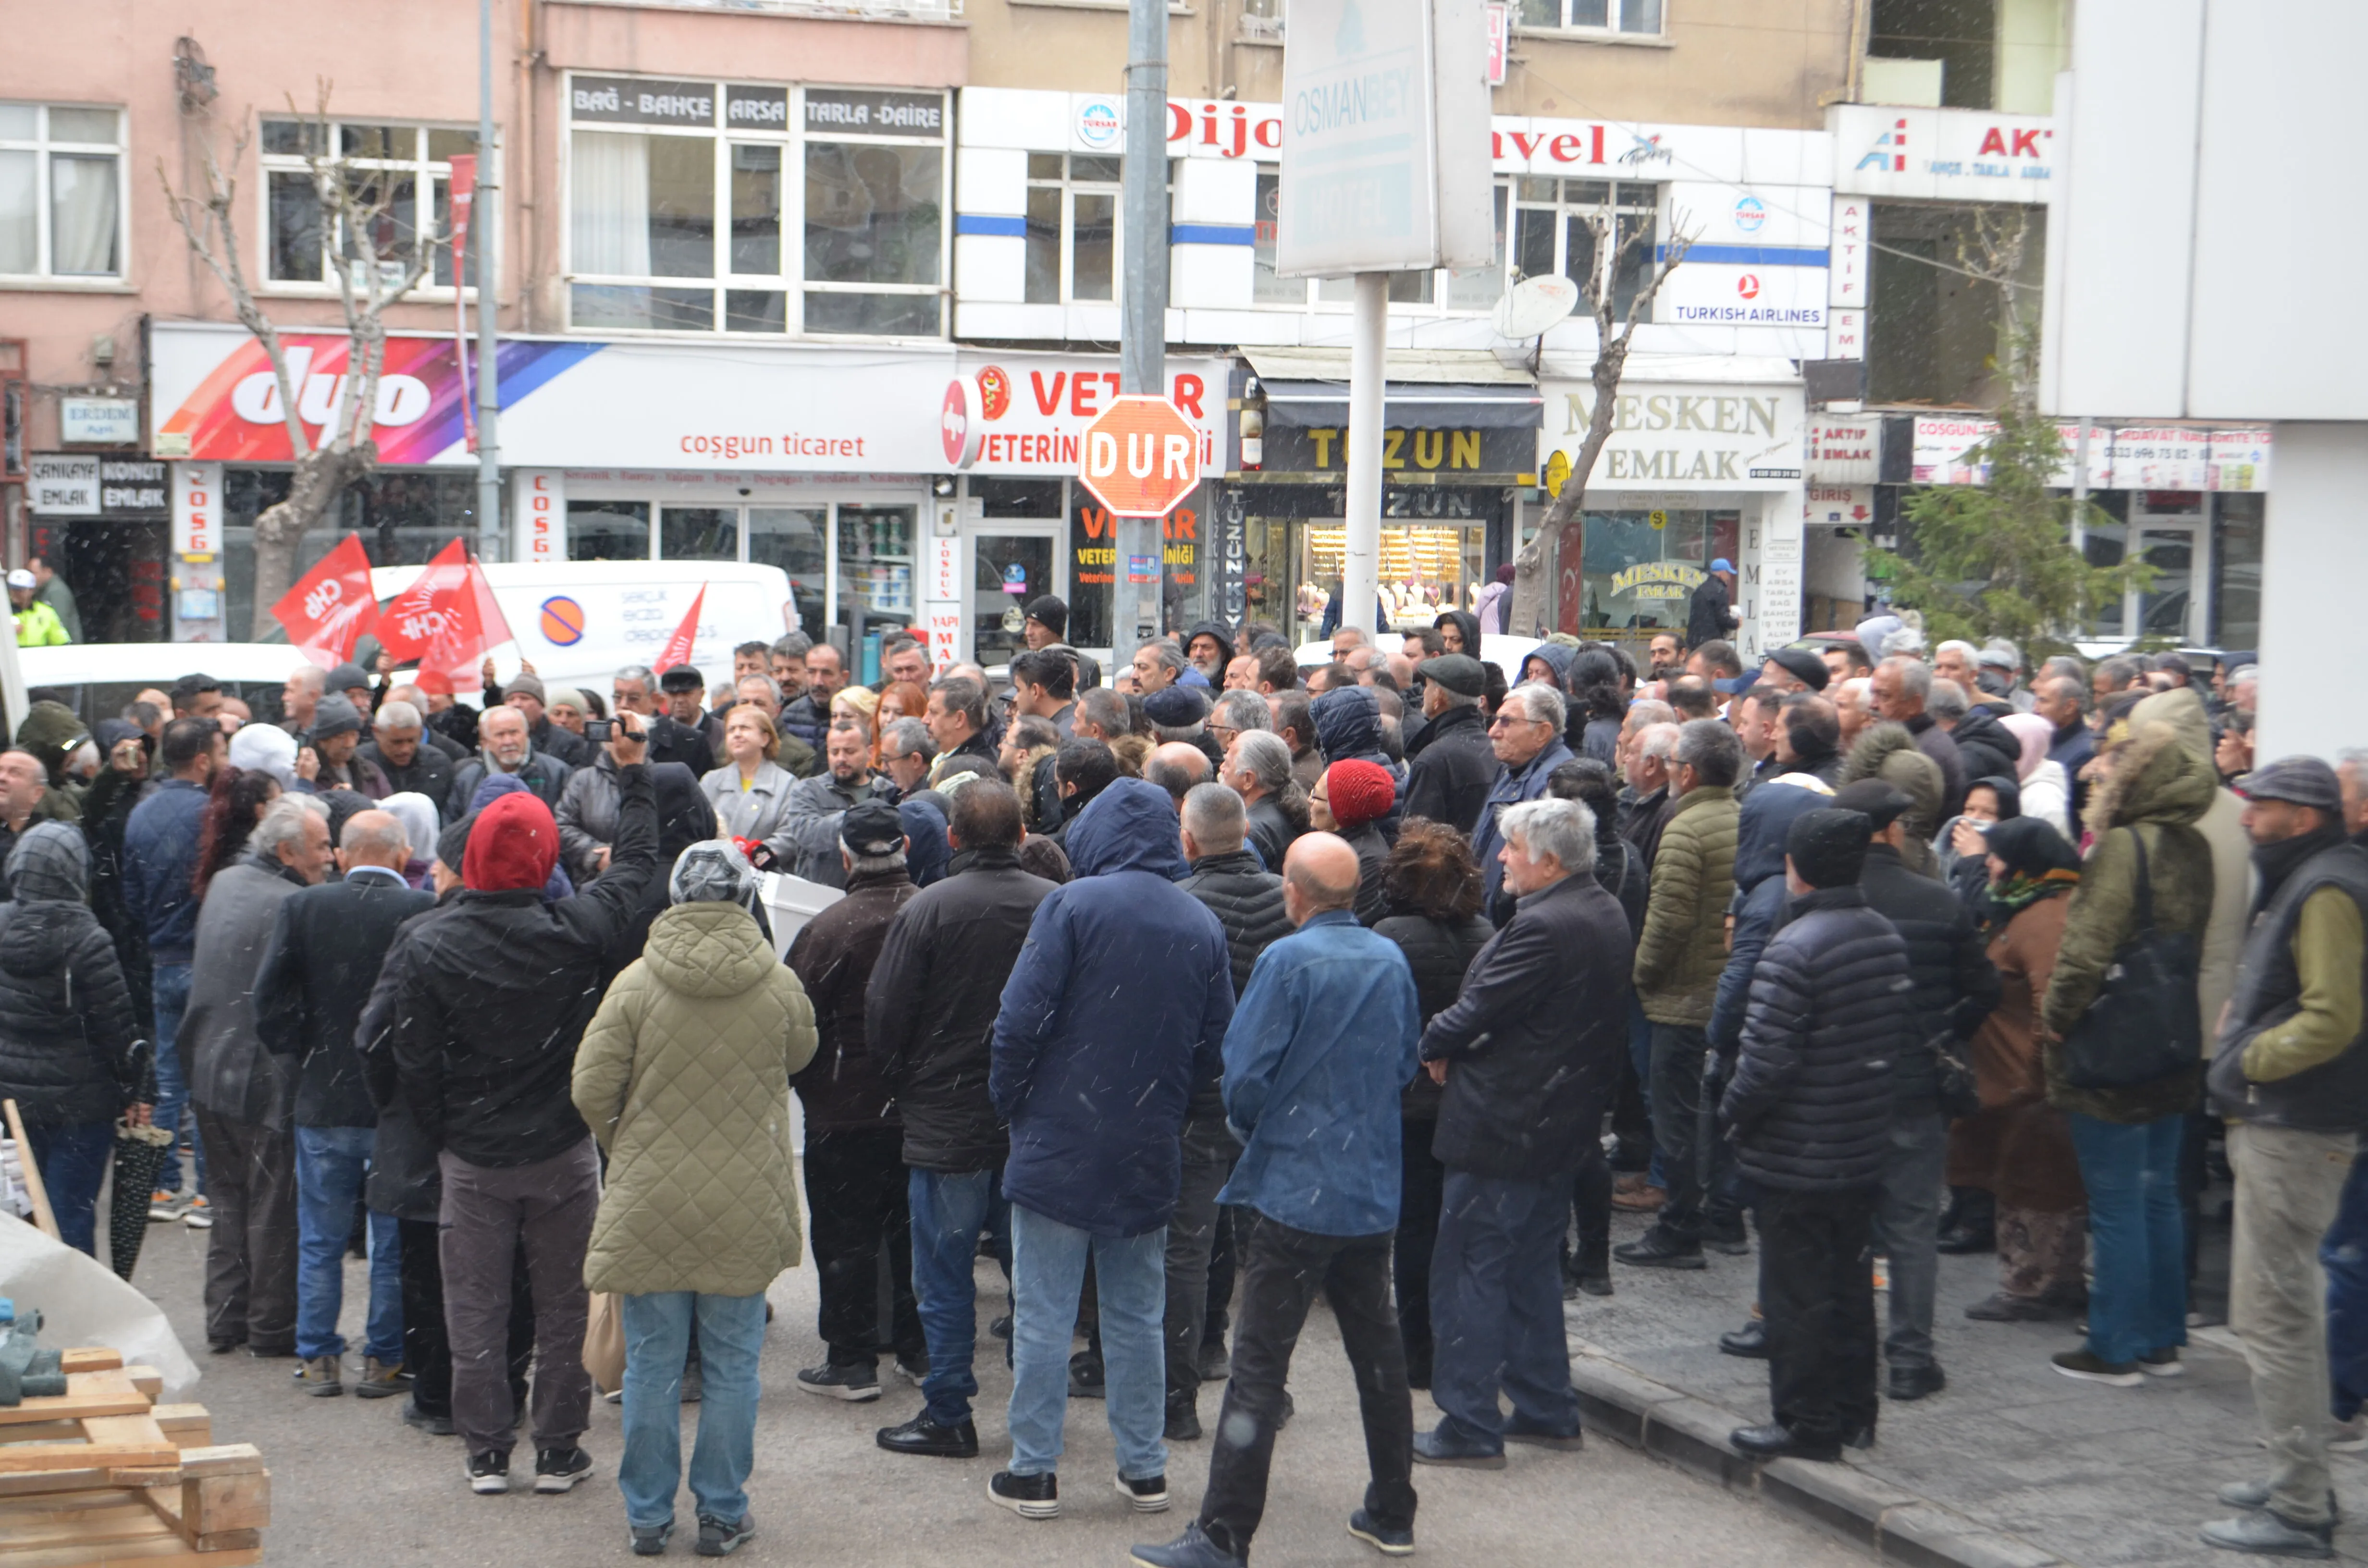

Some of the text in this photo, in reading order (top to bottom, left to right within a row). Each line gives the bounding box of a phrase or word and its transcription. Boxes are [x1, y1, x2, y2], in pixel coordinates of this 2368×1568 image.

[573, 86, 619, 112] BAĞ
[638, 93, 712, 120] BAHÇE
[728, 99, 786, 121] ARSA
[806, 100, 868, 124] TARLA
[1295, 67, 1411, 137] OSMANBEY
[1978, 127, 2053, 158] AK
[1677, 306, 1820, 323] TURKISH AIRLINES
[232, 345, 432, 450] dyo
[1563, 393, 1780, 438] MESKEN
[680, 432, 865, 459] coşgun ticaret
[1091, 432, 1189, 479] DUR
[1823, 449, 1872, 460] EMLAK
[101, 462, 166, 481] KONUT
[1605, 449, 1740, 480] EMLAK
[41, 488, 88, 506] EMLAK
[102, 487, 166, 507] EMLAK
[1226, 490, 1244, 574] TÜZÜN
[1653, 512, 1663, 525] S
[1611, 562, 1709, 597] MESKEN
[1636, 584, 1685, 600] EMLAK
[1744, 529, 1761, 655] EMLA
[304, 578, 343, 620] CHP
[932, 616, 959, 627] YAPI
